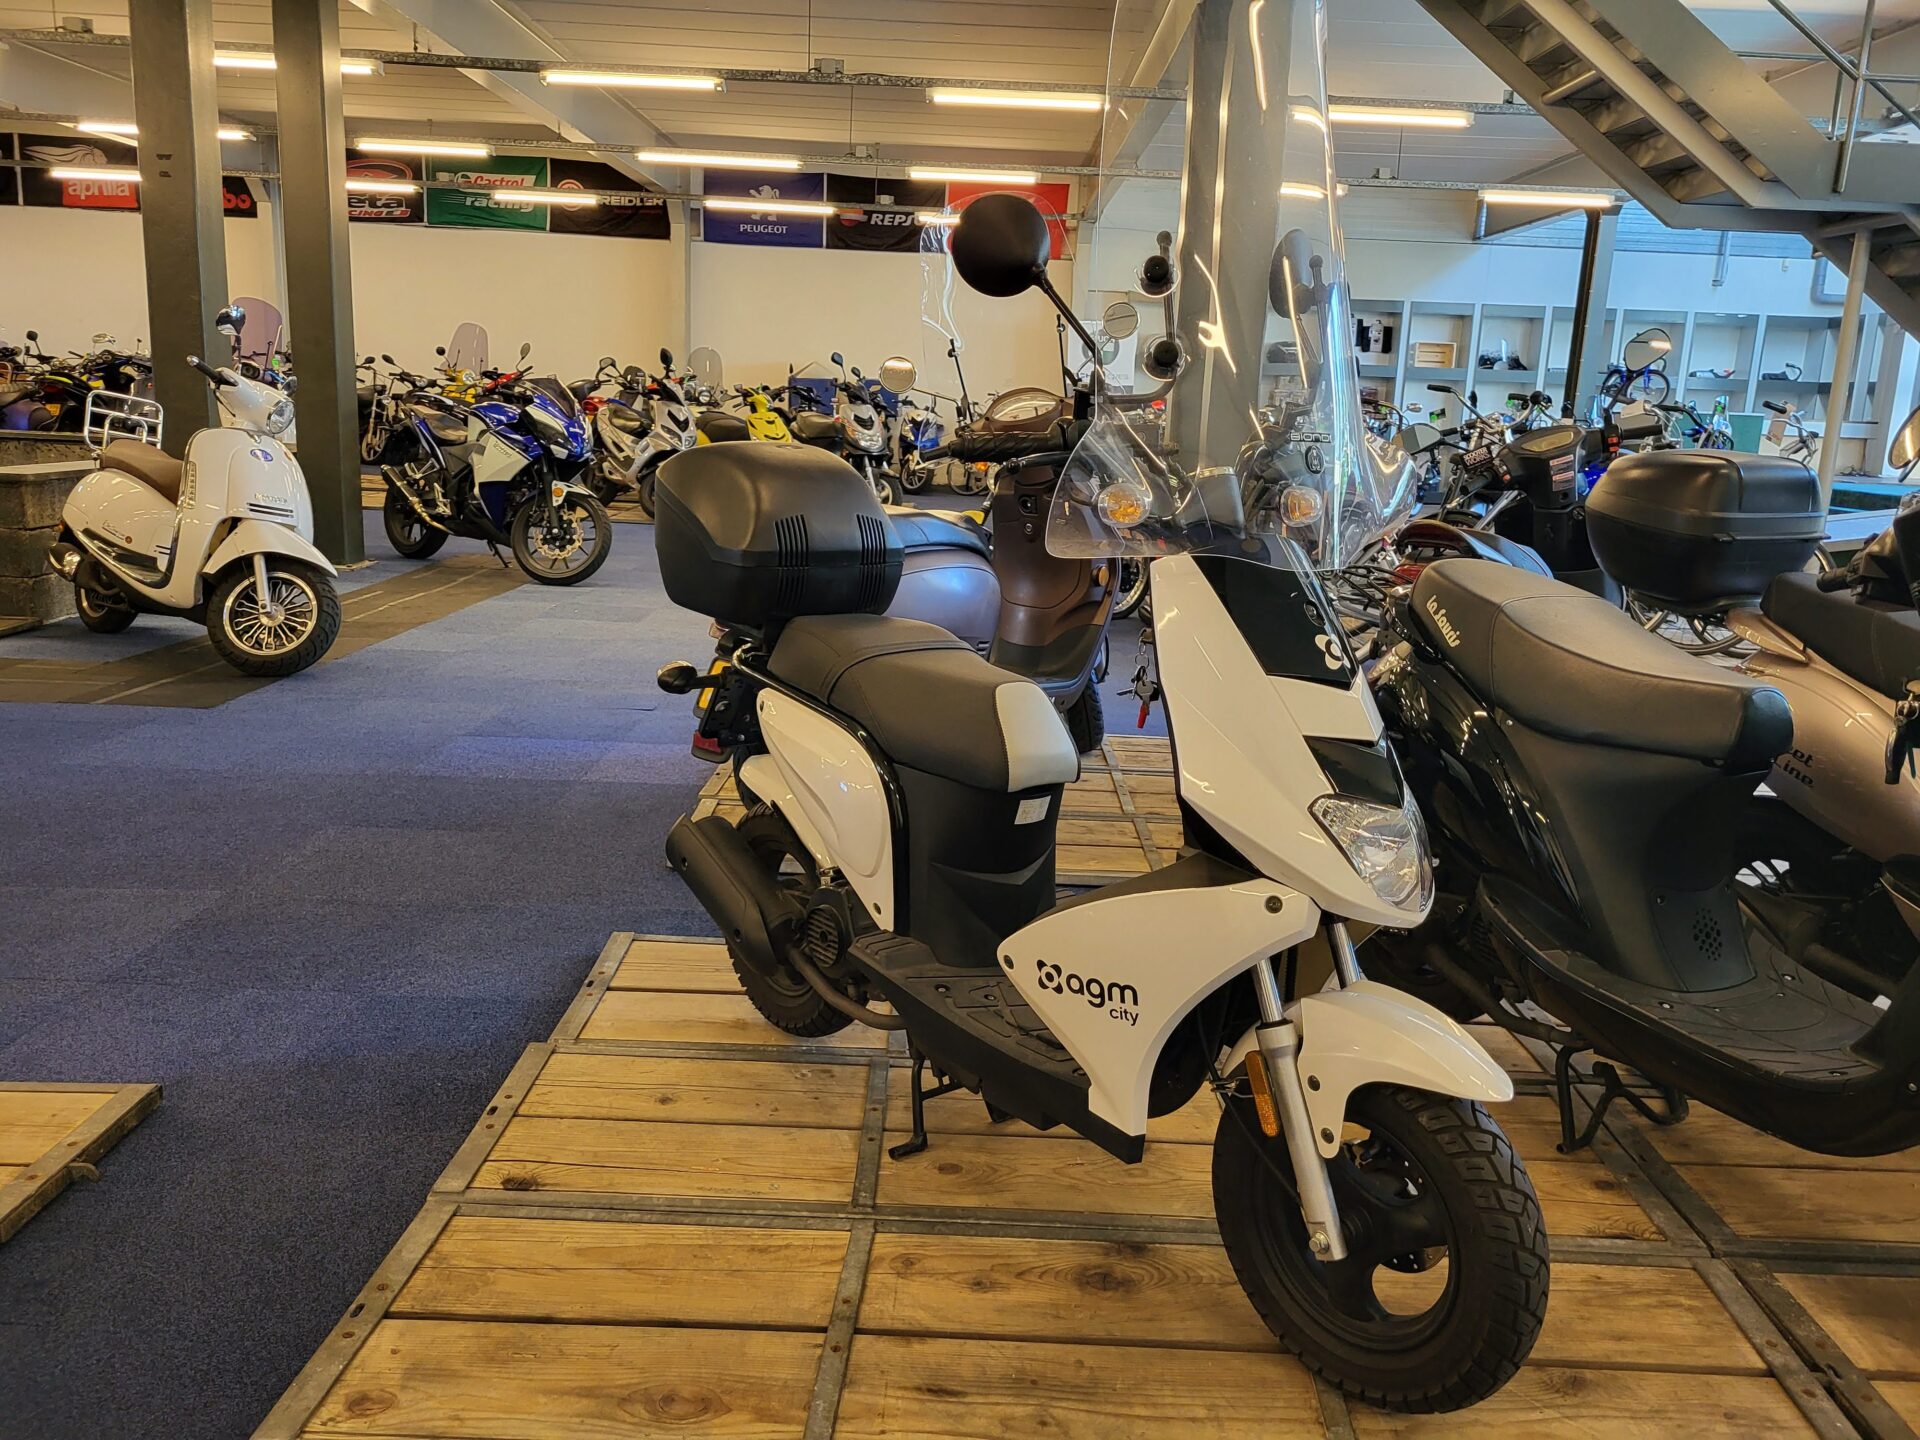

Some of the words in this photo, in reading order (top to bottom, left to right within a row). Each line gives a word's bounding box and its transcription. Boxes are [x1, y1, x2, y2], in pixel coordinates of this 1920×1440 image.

[68, 180, 130, 200] aprilia
[739, 224, 789, 235] PEUGEOT
[1065, 973, 1139, 1009] agm
[1109, 1006, 1139, 1027] city
